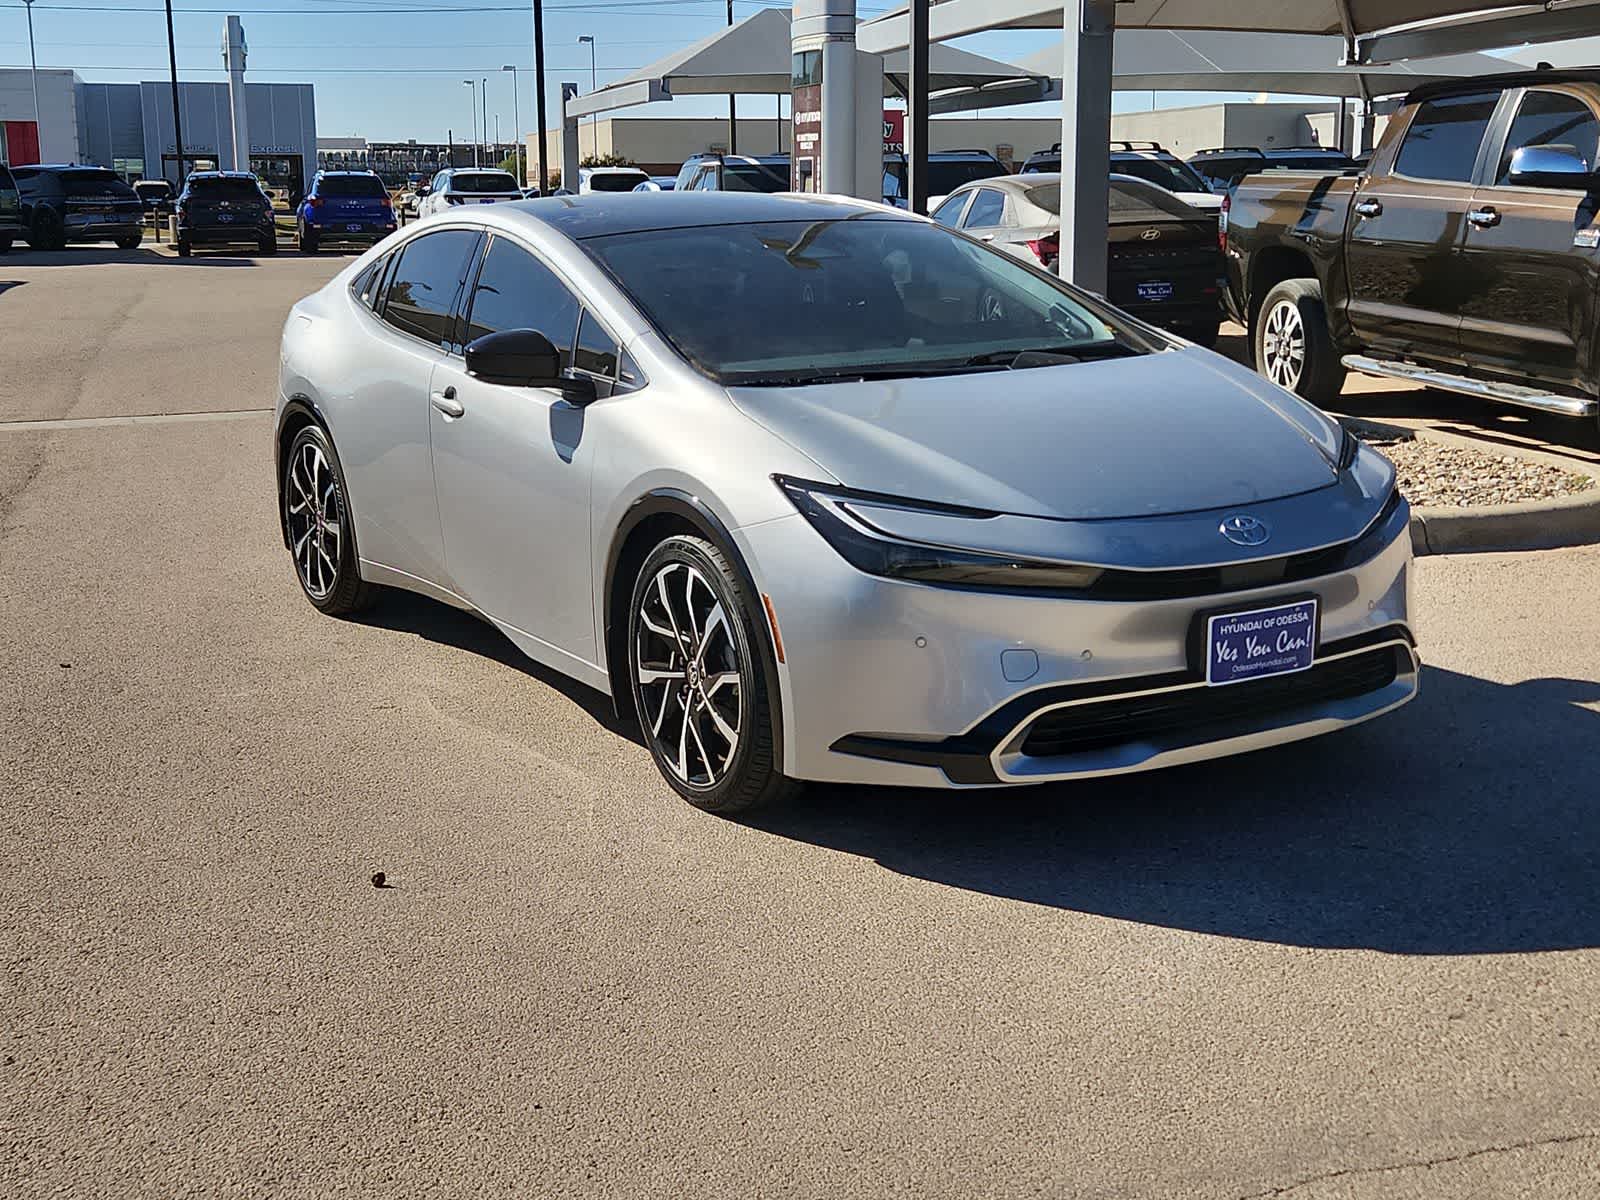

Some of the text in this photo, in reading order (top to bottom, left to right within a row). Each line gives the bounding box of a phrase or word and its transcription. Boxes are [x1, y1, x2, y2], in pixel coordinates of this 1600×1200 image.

[1220, 612, 1309, 635] HYUNDAI OF ODESSA
[1216, 624, 1312, 663] Yes You Can!
